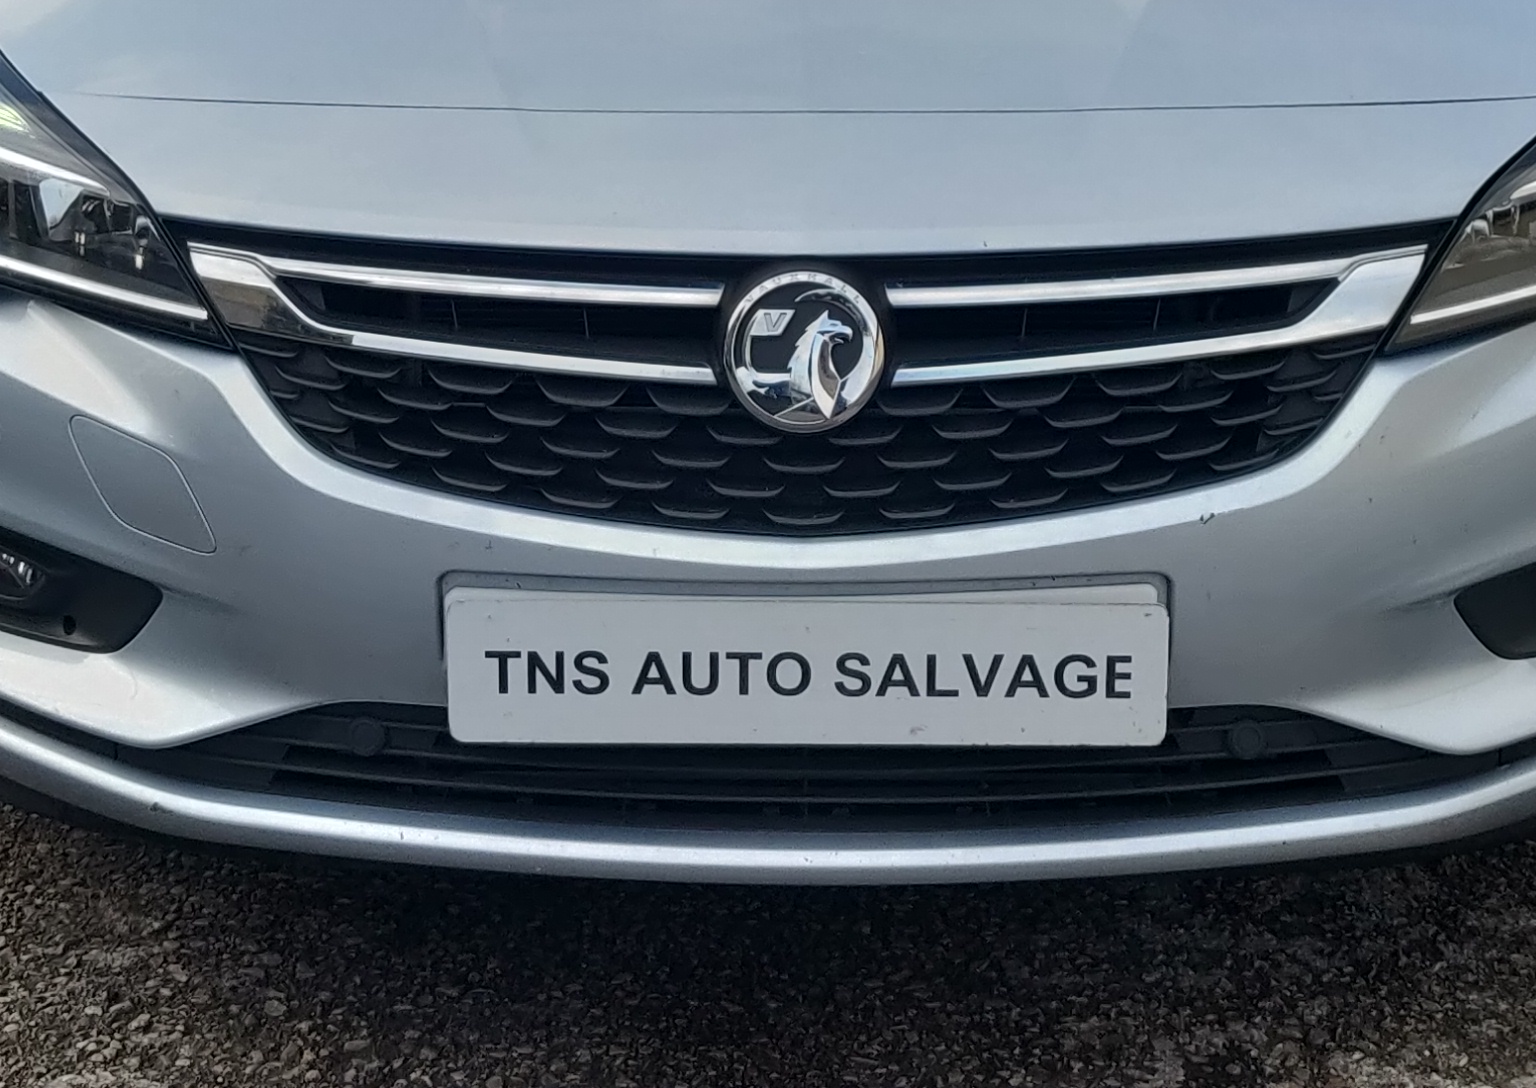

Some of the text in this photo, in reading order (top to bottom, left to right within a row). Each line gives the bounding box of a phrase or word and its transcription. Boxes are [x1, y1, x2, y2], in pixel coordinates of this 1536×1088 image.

[745, 272, 861, 305] VAUXHALL
[484, 650, 1133, 699] TNS AUTO SALVAGE
